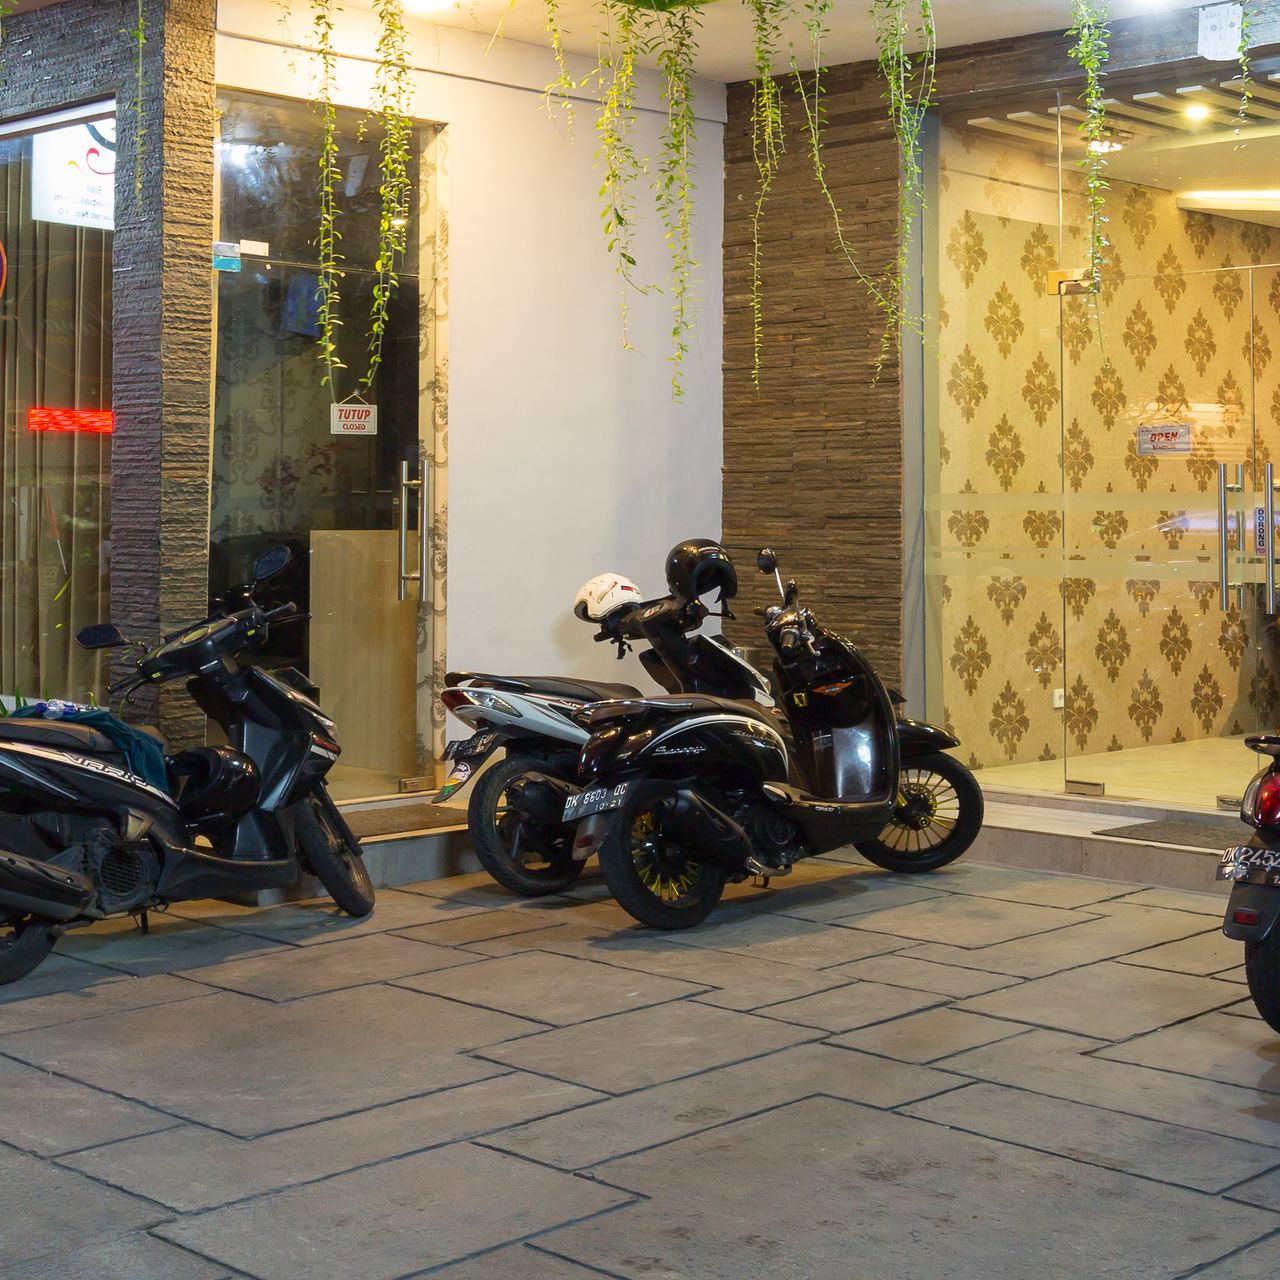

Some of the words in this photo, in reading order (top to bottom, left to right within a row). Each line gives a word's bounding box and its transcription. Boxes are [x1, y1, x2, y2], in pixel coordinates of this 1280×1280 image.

[338, 408, 371, 420] TUTUP
[1150, 431, 1178, 442] OPEN
[1257, 508, 1265, 547] DORONG
[565, 795, 580, 809] DK
[583, 787, 608, 805] 6603
[1221, 846, 1239, 863] DK
